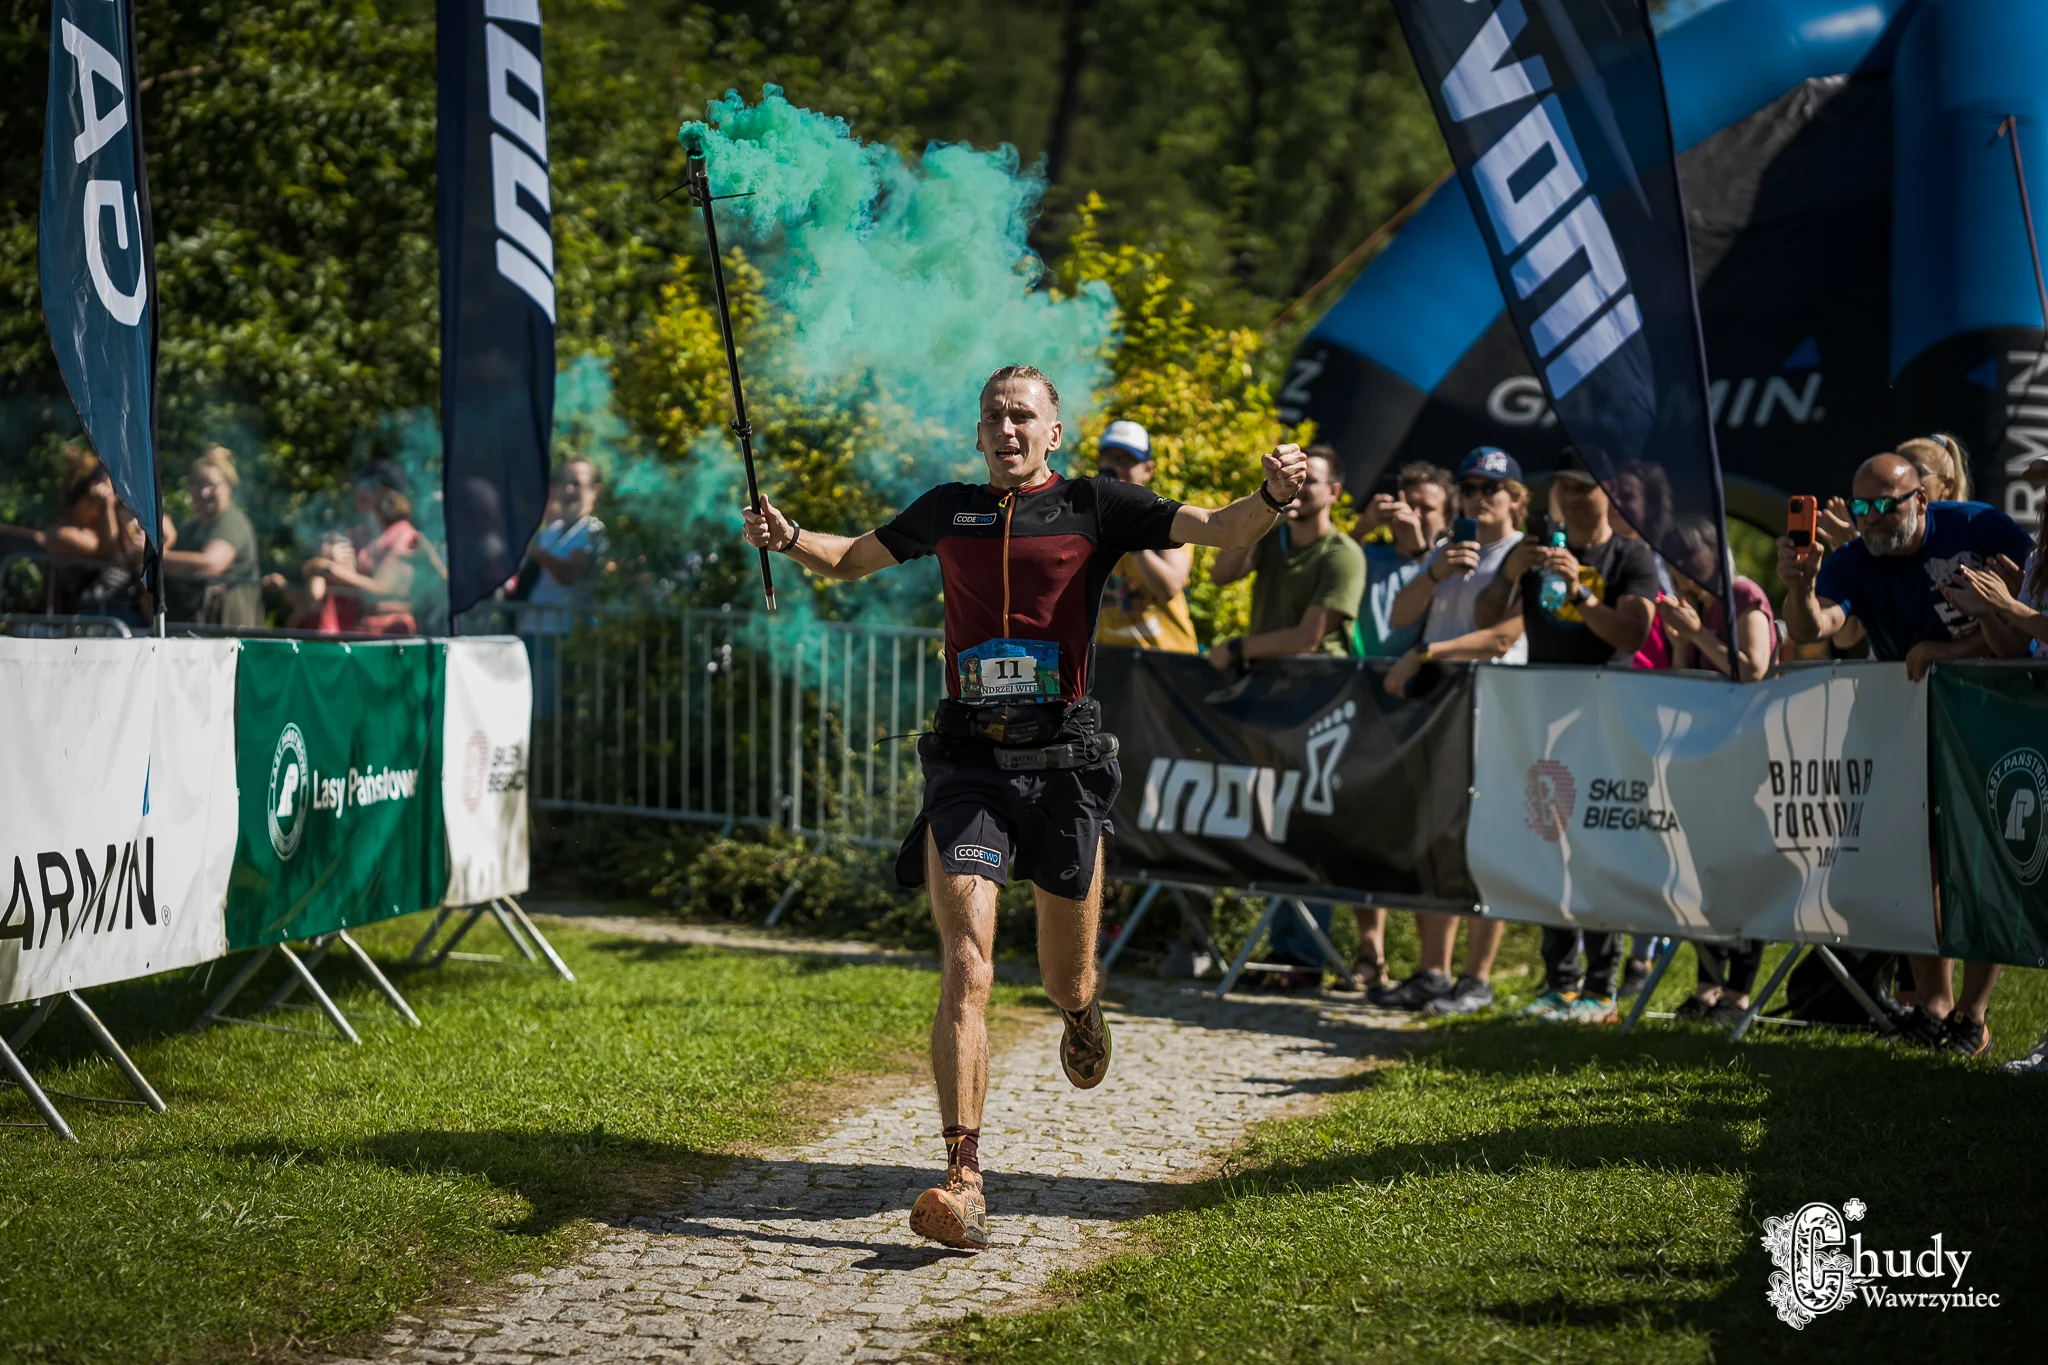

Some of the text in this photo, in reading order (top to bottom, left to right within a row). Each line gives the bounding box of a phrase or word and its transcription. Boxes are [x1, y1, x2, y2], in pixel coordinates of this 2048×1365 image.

[956, 515, 993, 523] CODETWO
[1011, 755, 1039, 763] MATRIX
[1588, 778, 1649, 803] SKLEP
[1769, 758, 1873, 797] BROWAR
[1988, 766, 2001, 811] LASY
[313, 769, 346, 819] Lasy
[1583, 806, 1680, 833] BIEGACZA
[958, 848, 999, 863] CODETWO
